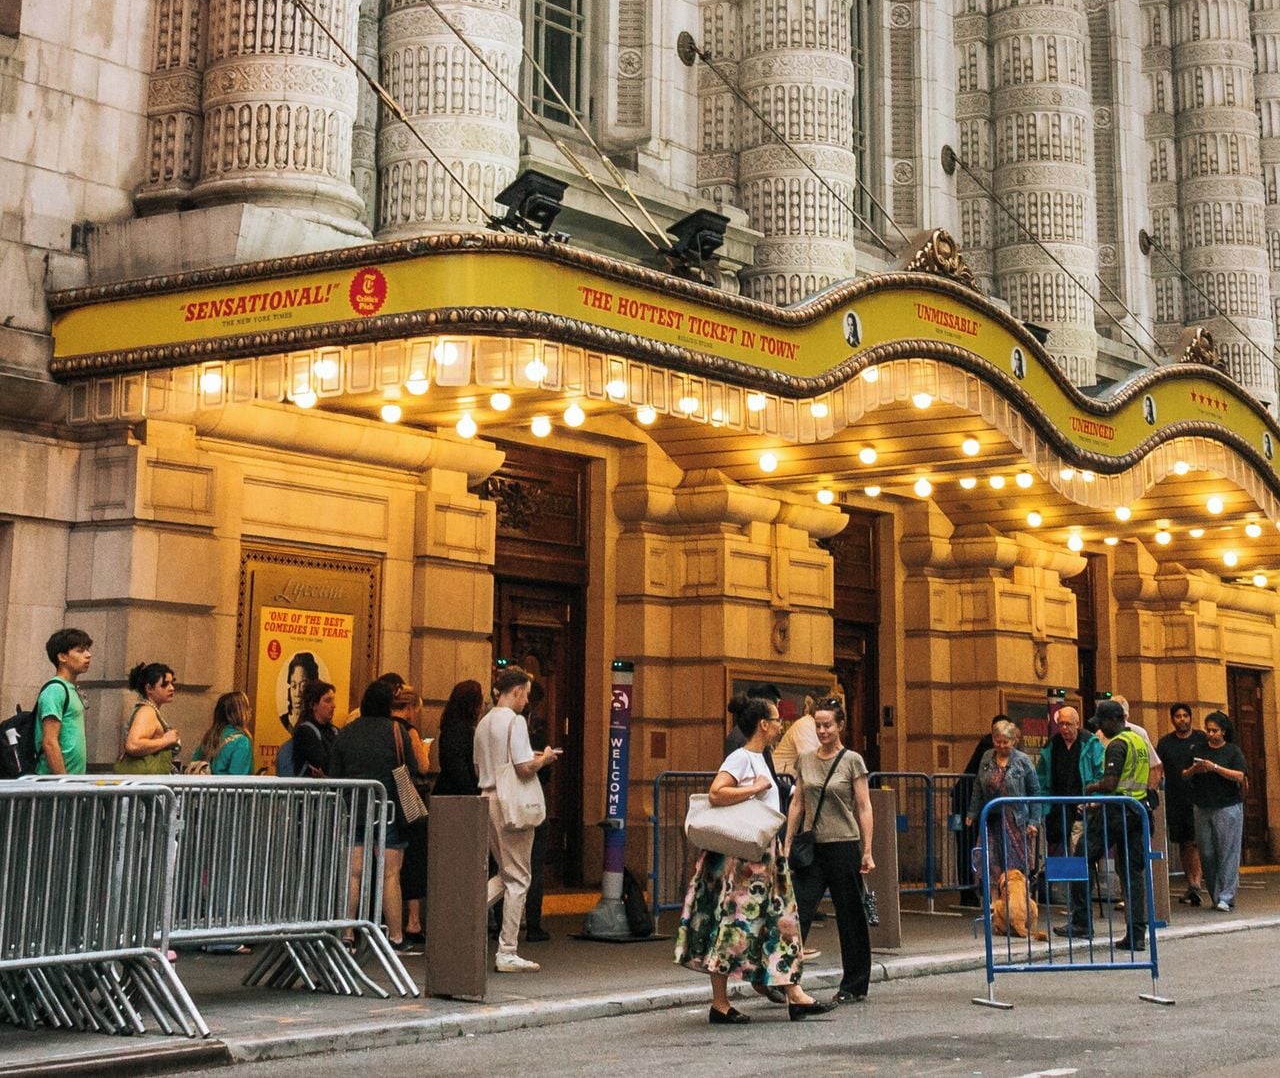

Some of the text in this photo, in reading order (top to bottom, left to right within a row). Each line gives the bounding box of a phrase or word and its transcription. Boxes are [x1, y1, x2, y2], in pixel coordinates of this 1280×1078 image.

[179, 283, 341, 322] "SENSATIONAL!"
[222, 312, 293, 328] THE NEW YORK TIMES
[577, 285, 613, 311] "THE
[617, 297, 684, 330] HOTTEST
[688, 315, 738, 345] TICKET
[740, 329, 756, 349] IN
[264, 621, 308, 635] COMEDIES
[309, 626, 320, 636] IN
[291, 613, 302, 624] OF
[305, 615, 322, 625] THE
[323, 616, 345, 628] BEST
[609, 737, 623, 815] WELCOME
